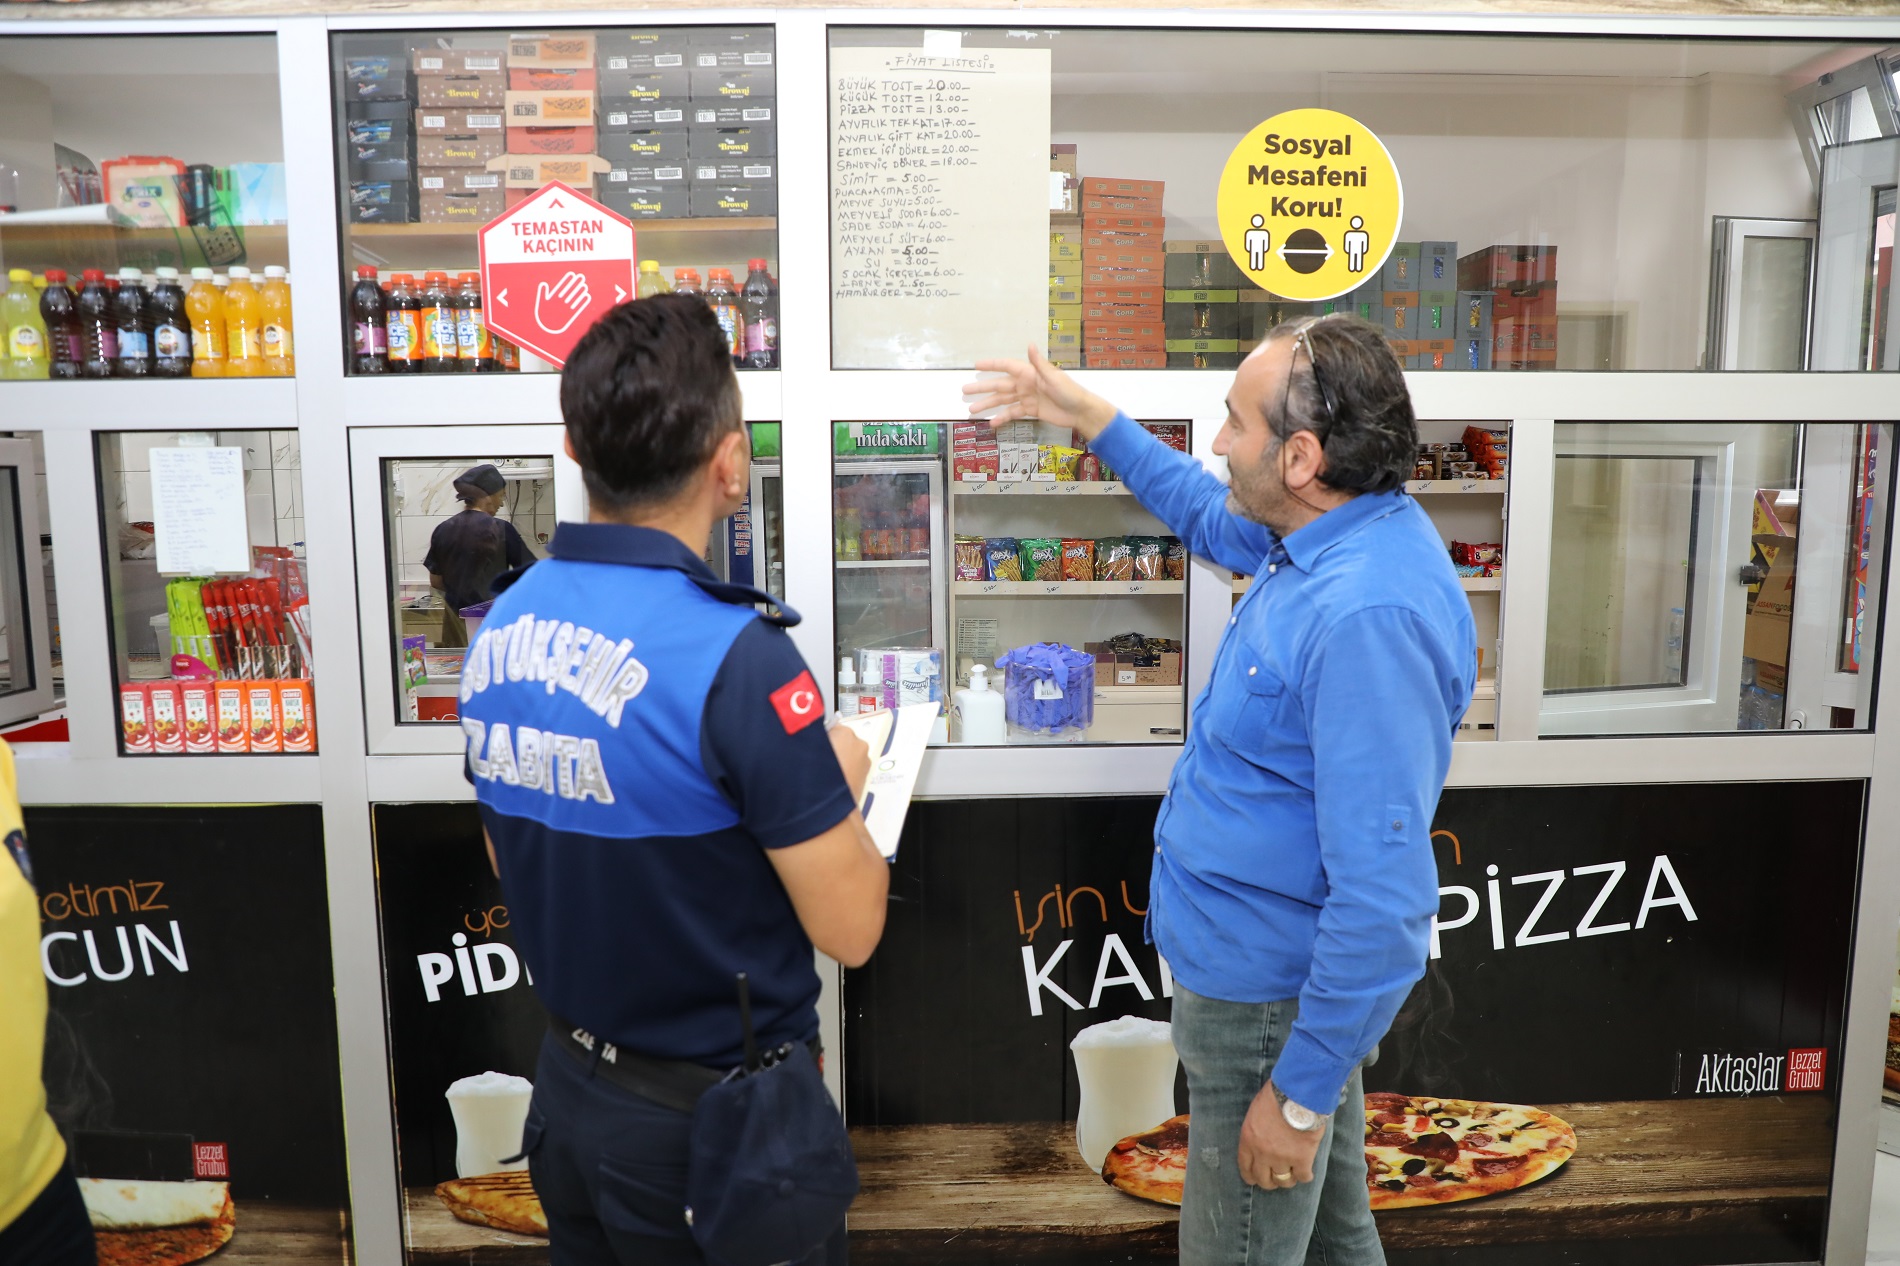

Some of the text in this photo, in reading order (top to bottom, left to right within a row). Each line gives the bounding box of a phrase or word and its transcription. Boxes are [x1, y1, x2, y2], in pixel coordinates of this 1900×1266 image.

[838, 77, 876, 91] BÜYÜK
[839, 91, 877, 103] KÜÇÜK
[882, 94, 912, 103] TOST
[882, 105, 913, 114] TOST
[838, 119, 887, 130] AYVALIK
[837, 133, 885, 145] AYVALIK
[1264, 134, 1351, 159] Sosyal
[838, 147, 877, 158] EKMEK
[1248, 165, 1367, 187] Mesafeni
[838, 199, 873, 209] MEYVE
[1271, 197, 1343, 217] Koru!
[512, 220, 603, 236] TEMASTAN
[840, 221, 872, 232] SADE
[877, 221, 904, 230] SODA
[523, 238, 594, 256] KAÇININ
[865, 258, 881, 268] SU
[461, 716, 615, 804] ZABITA
[39, 880, 169, 922] etimiz
[1429, 854, 1699, 960] PİZZA
[417, 932, 533, 1003] PİD
[1791, 1051, 1822, 1070] Lezzet
[1789, 1070, 1821, 1088] Grubu
[195, 1144, 224, 1160] Lezzet
[197, 1160, 226, 1176] Grubu
